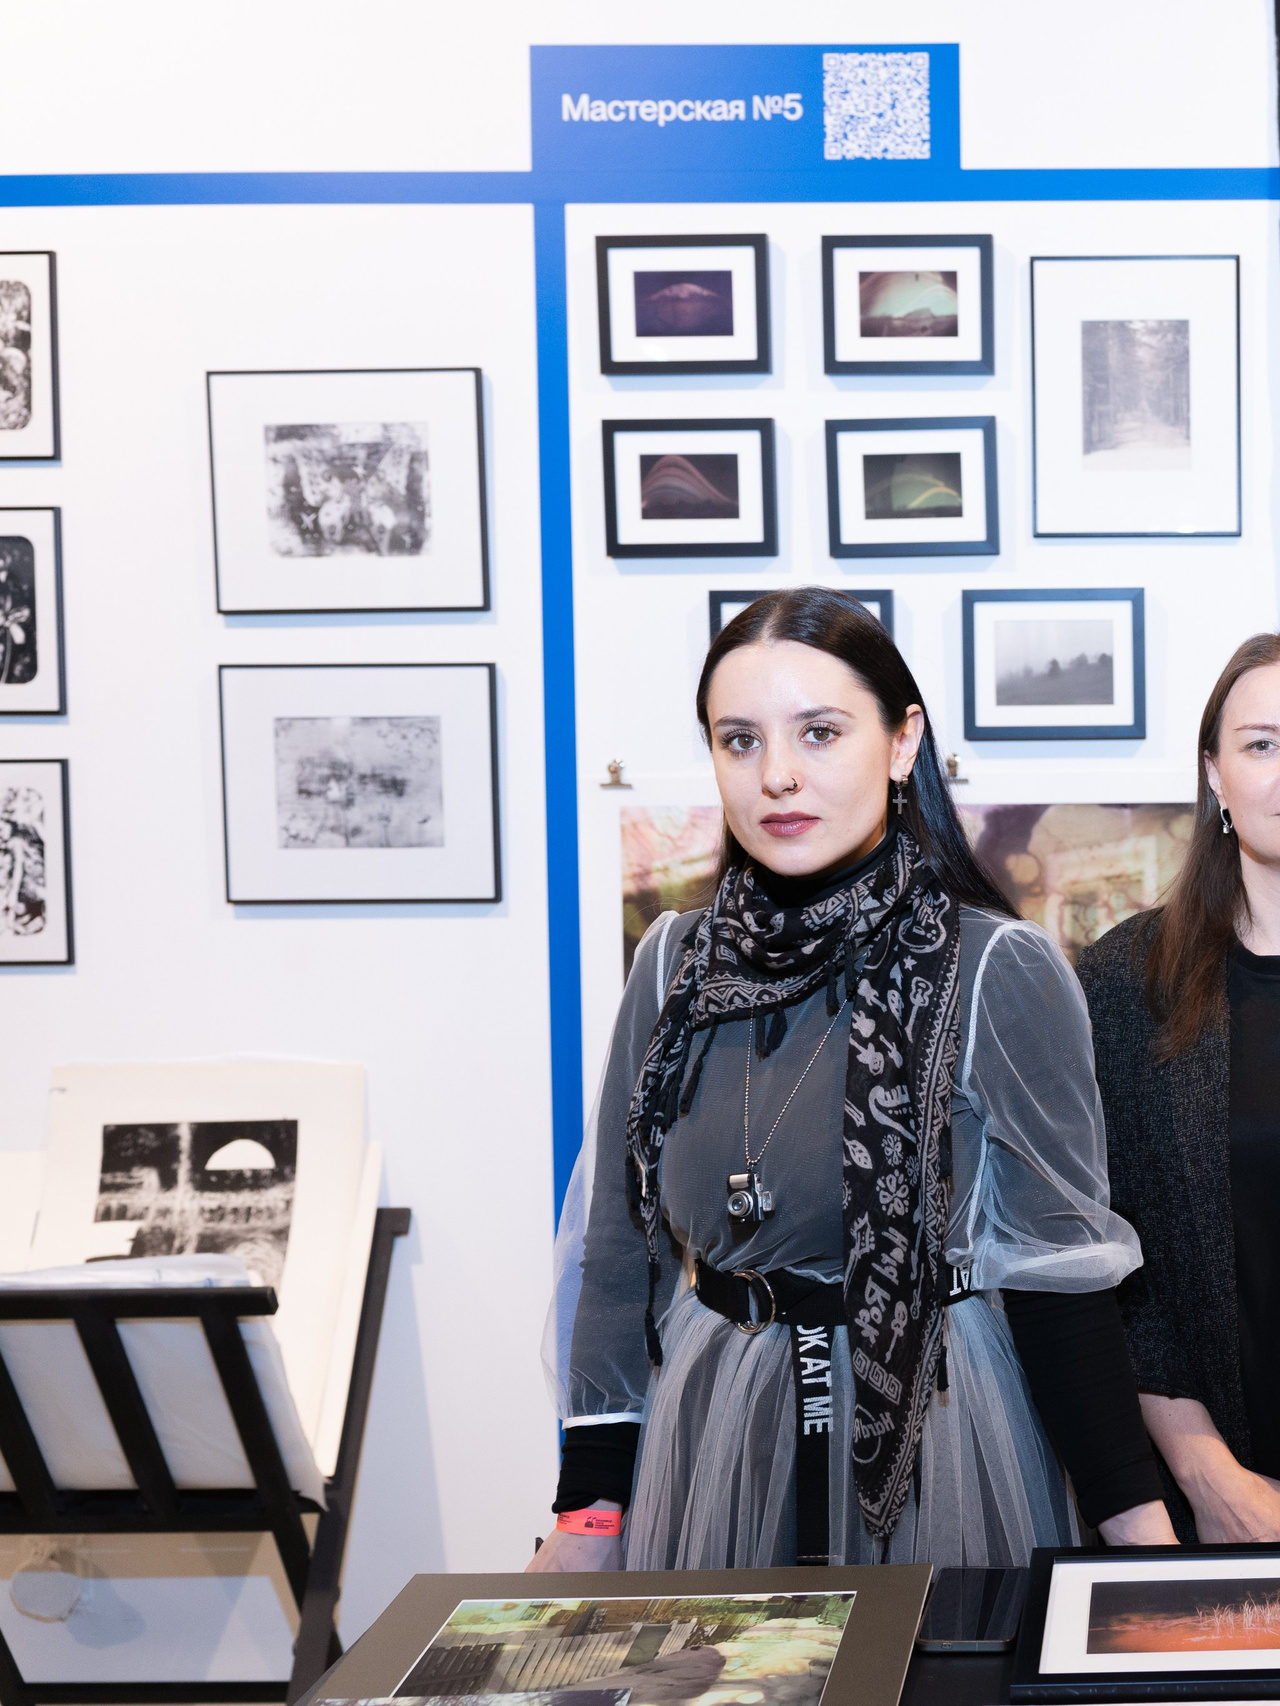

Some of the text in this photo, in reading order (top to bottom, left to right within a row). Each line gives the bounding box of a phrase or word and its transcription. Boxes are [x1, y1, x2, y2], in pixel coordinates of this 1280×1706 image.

[561, 92, 804, 127] Мастерская №5
[799, 1357, 833, 1388] AT
[803, 1395, 834, 1436] ME
